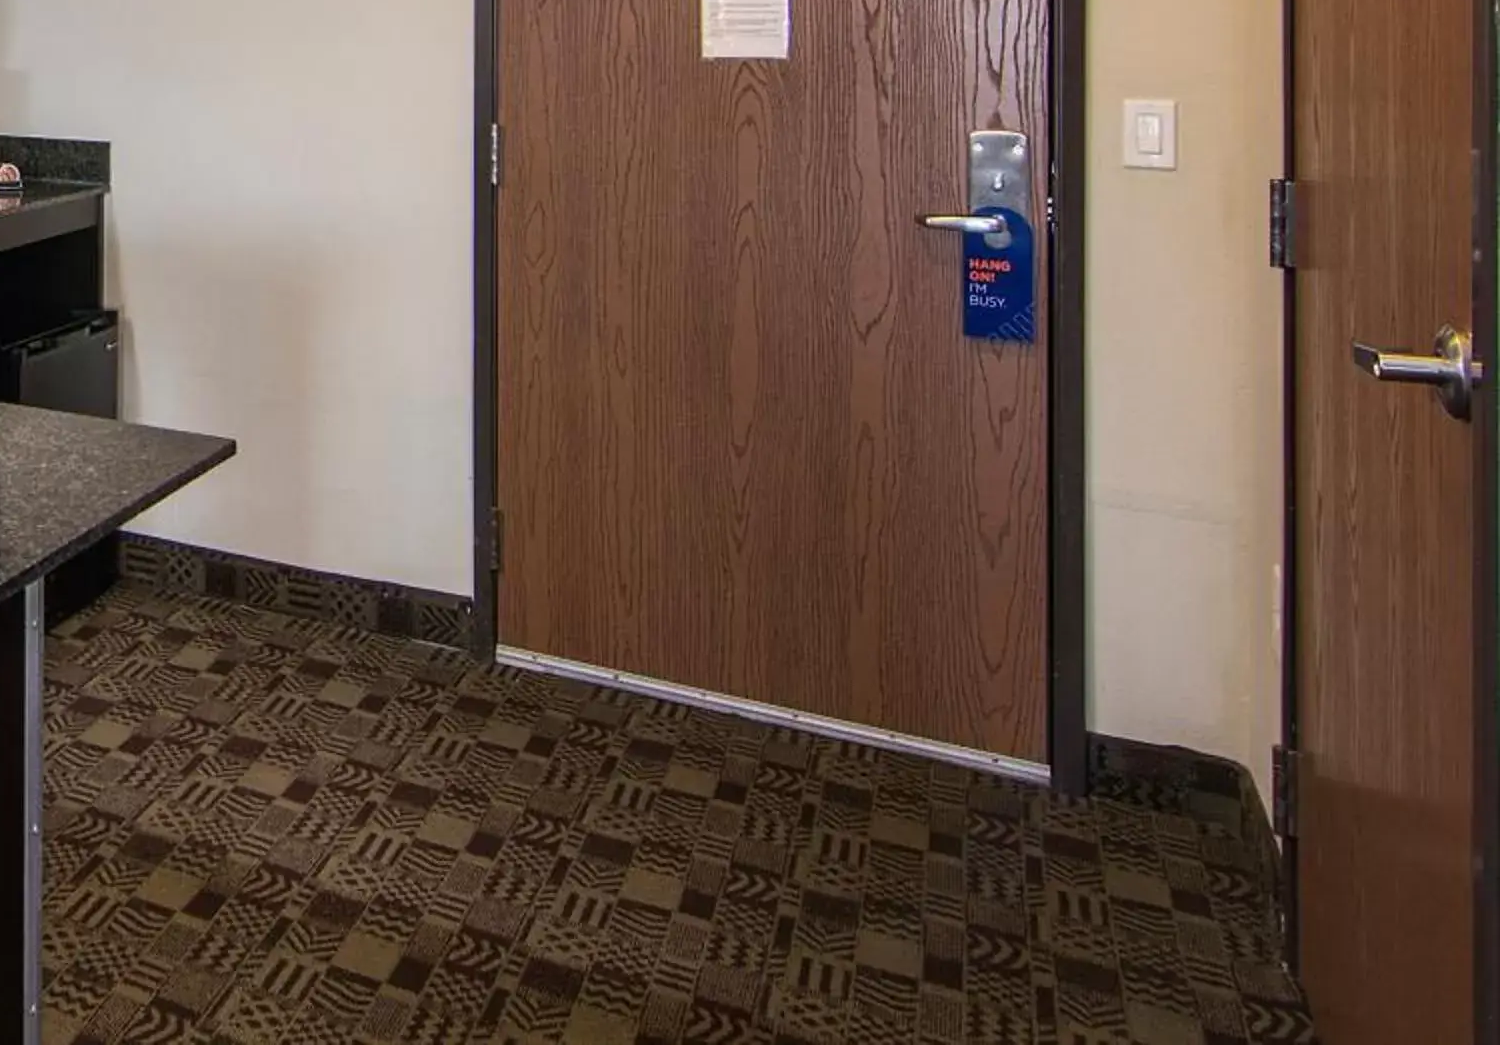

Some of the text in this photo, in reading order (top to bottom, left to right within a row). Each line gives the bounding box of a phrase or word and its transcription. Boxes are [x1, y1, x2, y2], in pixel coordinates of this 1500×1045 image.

[969, 259, 1011, 271] HANG
[969, 271, 996, 283] ON!
[969, 283, 987, 293] I'M
